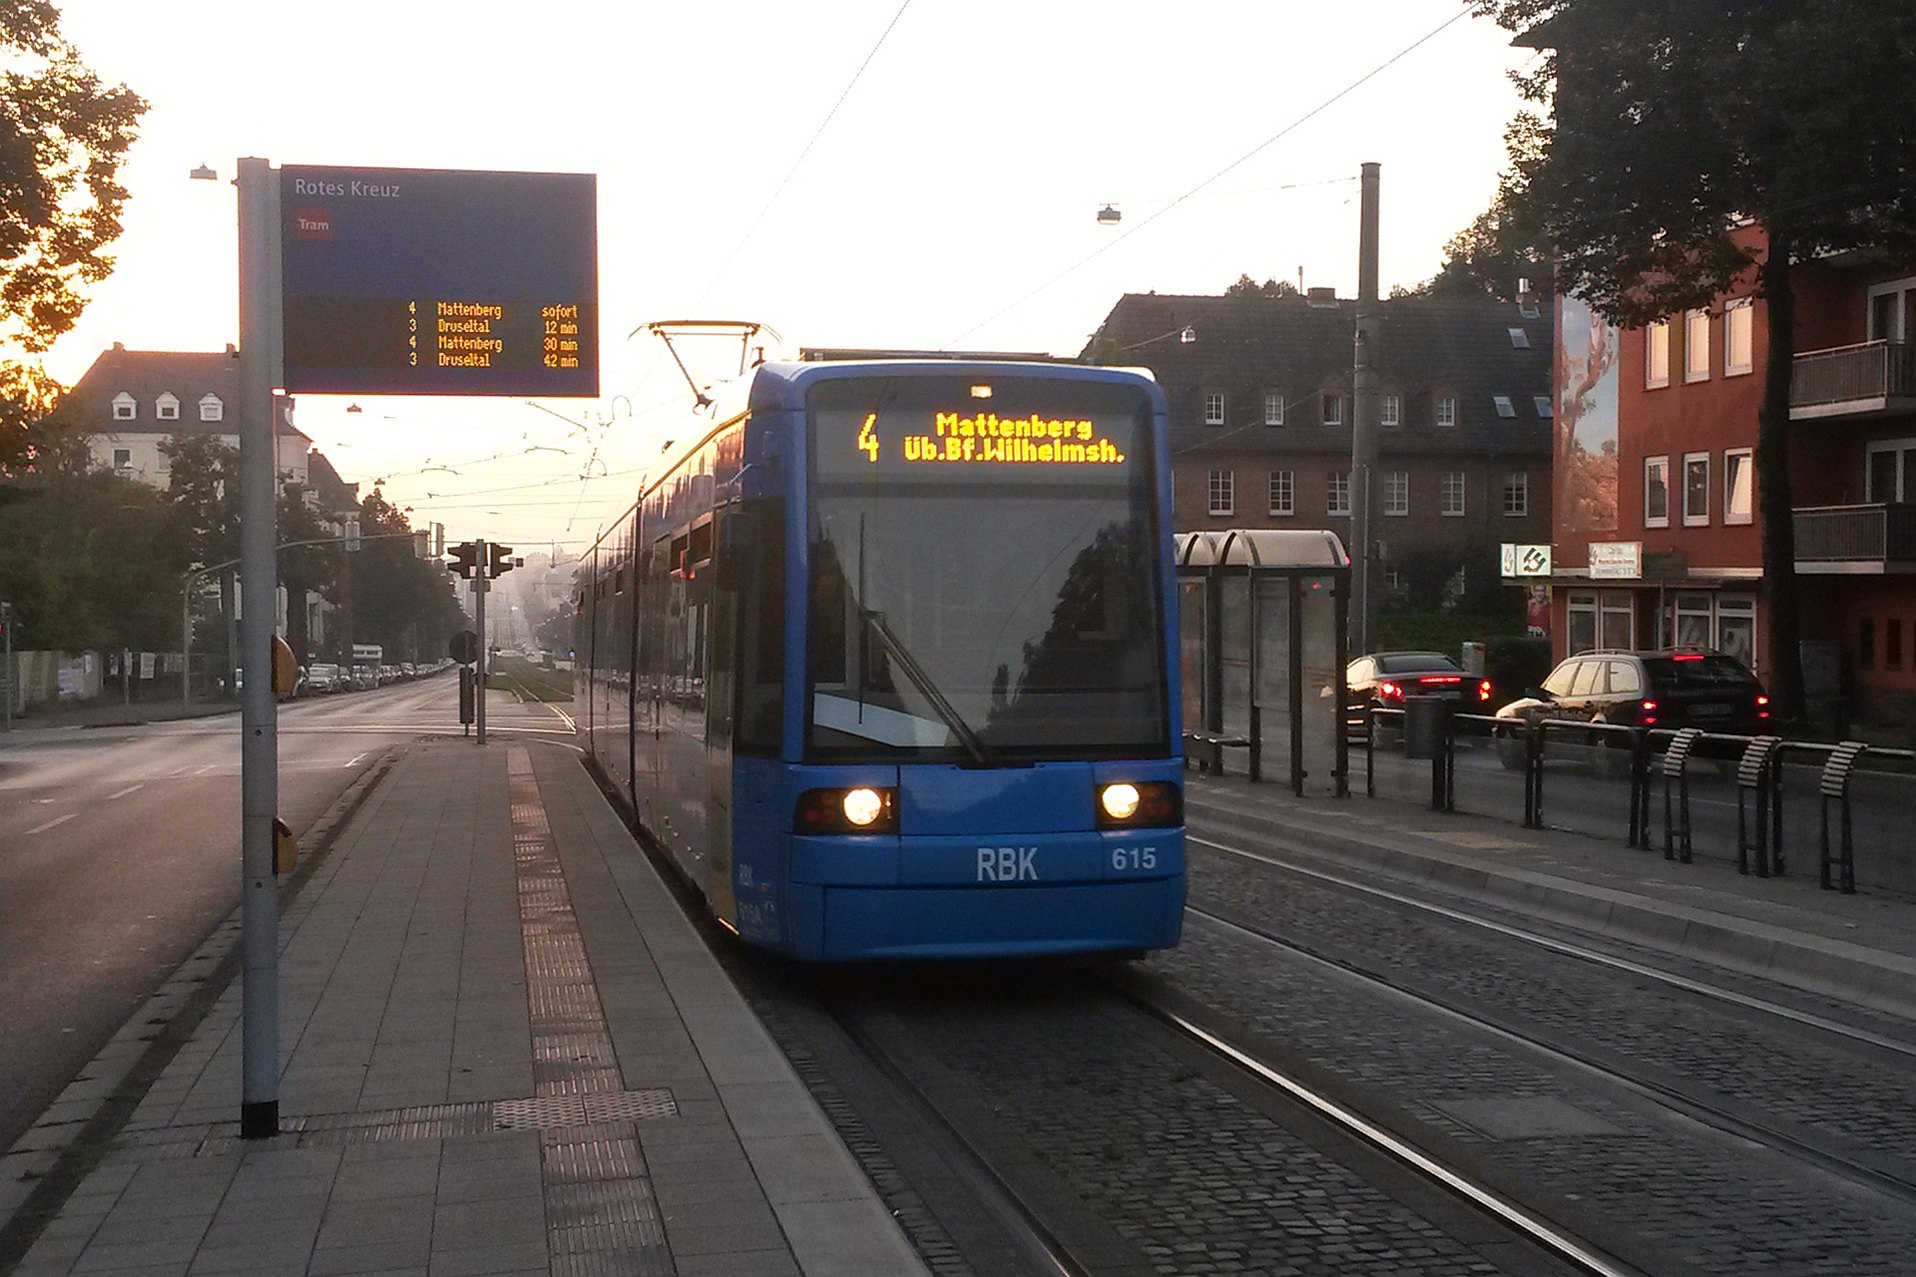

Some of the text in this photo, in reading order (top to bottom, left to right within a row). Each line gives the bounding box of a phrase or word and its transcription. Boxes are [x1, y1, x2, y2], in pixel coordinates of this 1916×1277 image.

[295, 179, 400, 198] Rotes Kreuz
[299, 218, 329, 231] Tram
[408, 302, 578, 320] 4 Mattenberg sofort
[409, 319, 578, 334] 3 Druseltal 12 min
[409, 336, 578, 353] 4 Mattenberg 30 min
[409, 353, 579, 368] 3 Druseltal 42 min
[935, 411, 1093, 440] Mattenberg
[857, 412, 880, 463] 4
[976, 847, 1039, 882] RBK
[1112, 846, 1157, 872] 615
